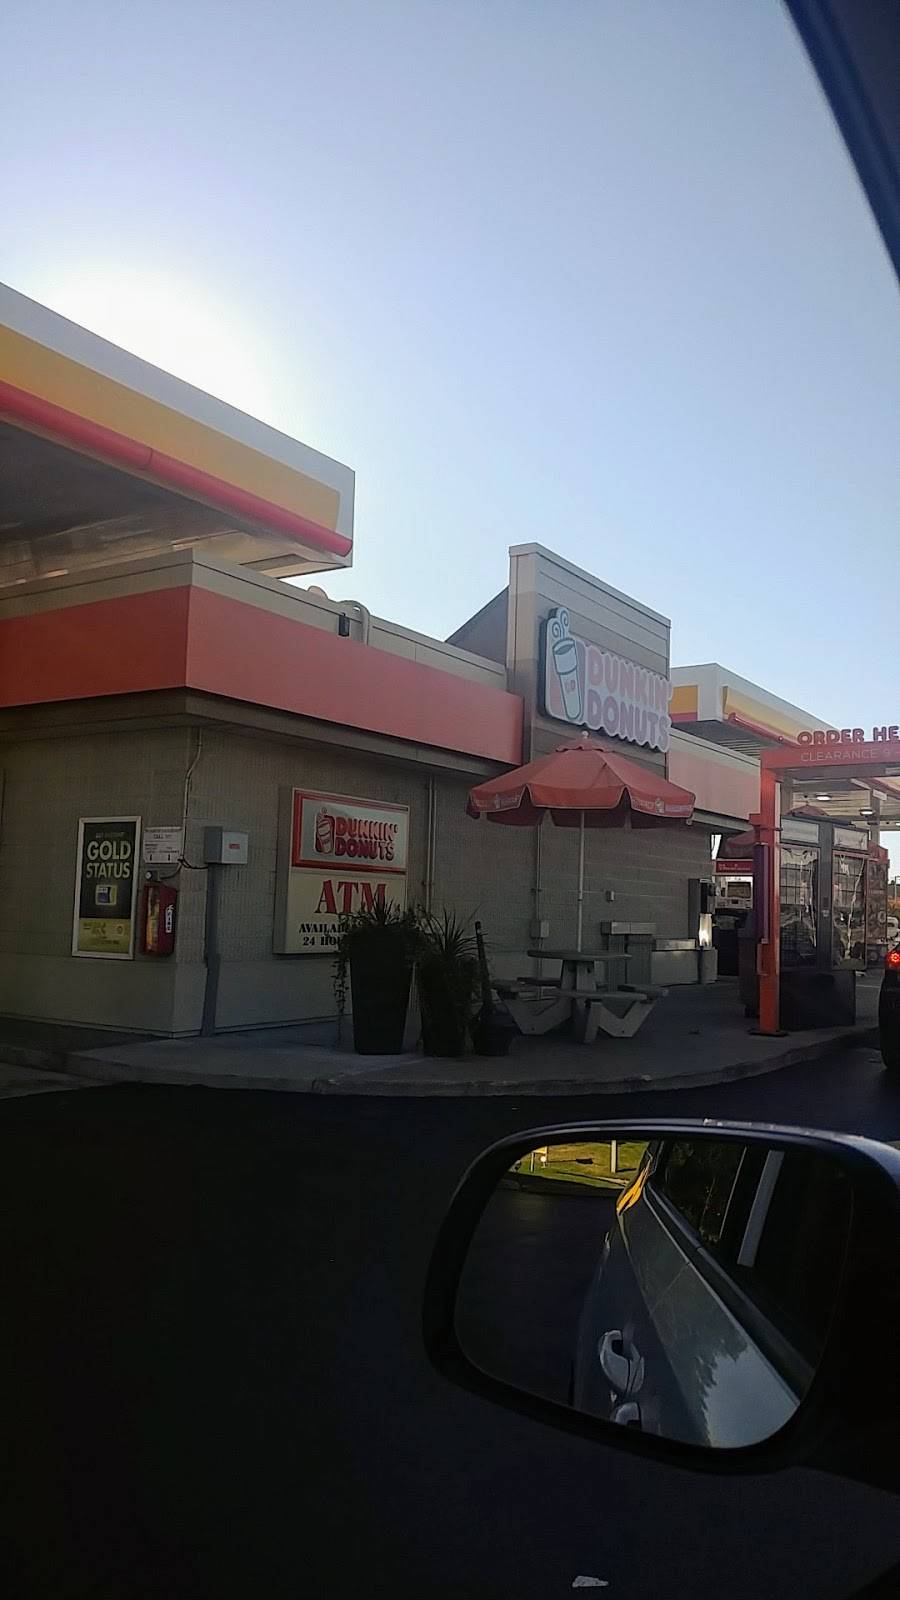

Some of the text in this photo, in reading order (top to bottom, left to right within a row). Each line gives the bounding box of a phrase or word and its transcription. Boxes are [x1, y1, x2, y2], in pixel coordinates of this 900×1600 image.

[587, 688, 669, 750] DONUTS
[797, 728, 865, 746] ORDER
[800, 749, 877, 762] CLEARANCE
[335, 817, 398, 842] DUNKIN'
[86, 840, 132, 860] GOLD
[334, 836, 394, 861] DONUTS
[85, 862, 131, 879] STATUS
[314, 880, 387, 916] ATM
[303, 936, 315, 946] 24
